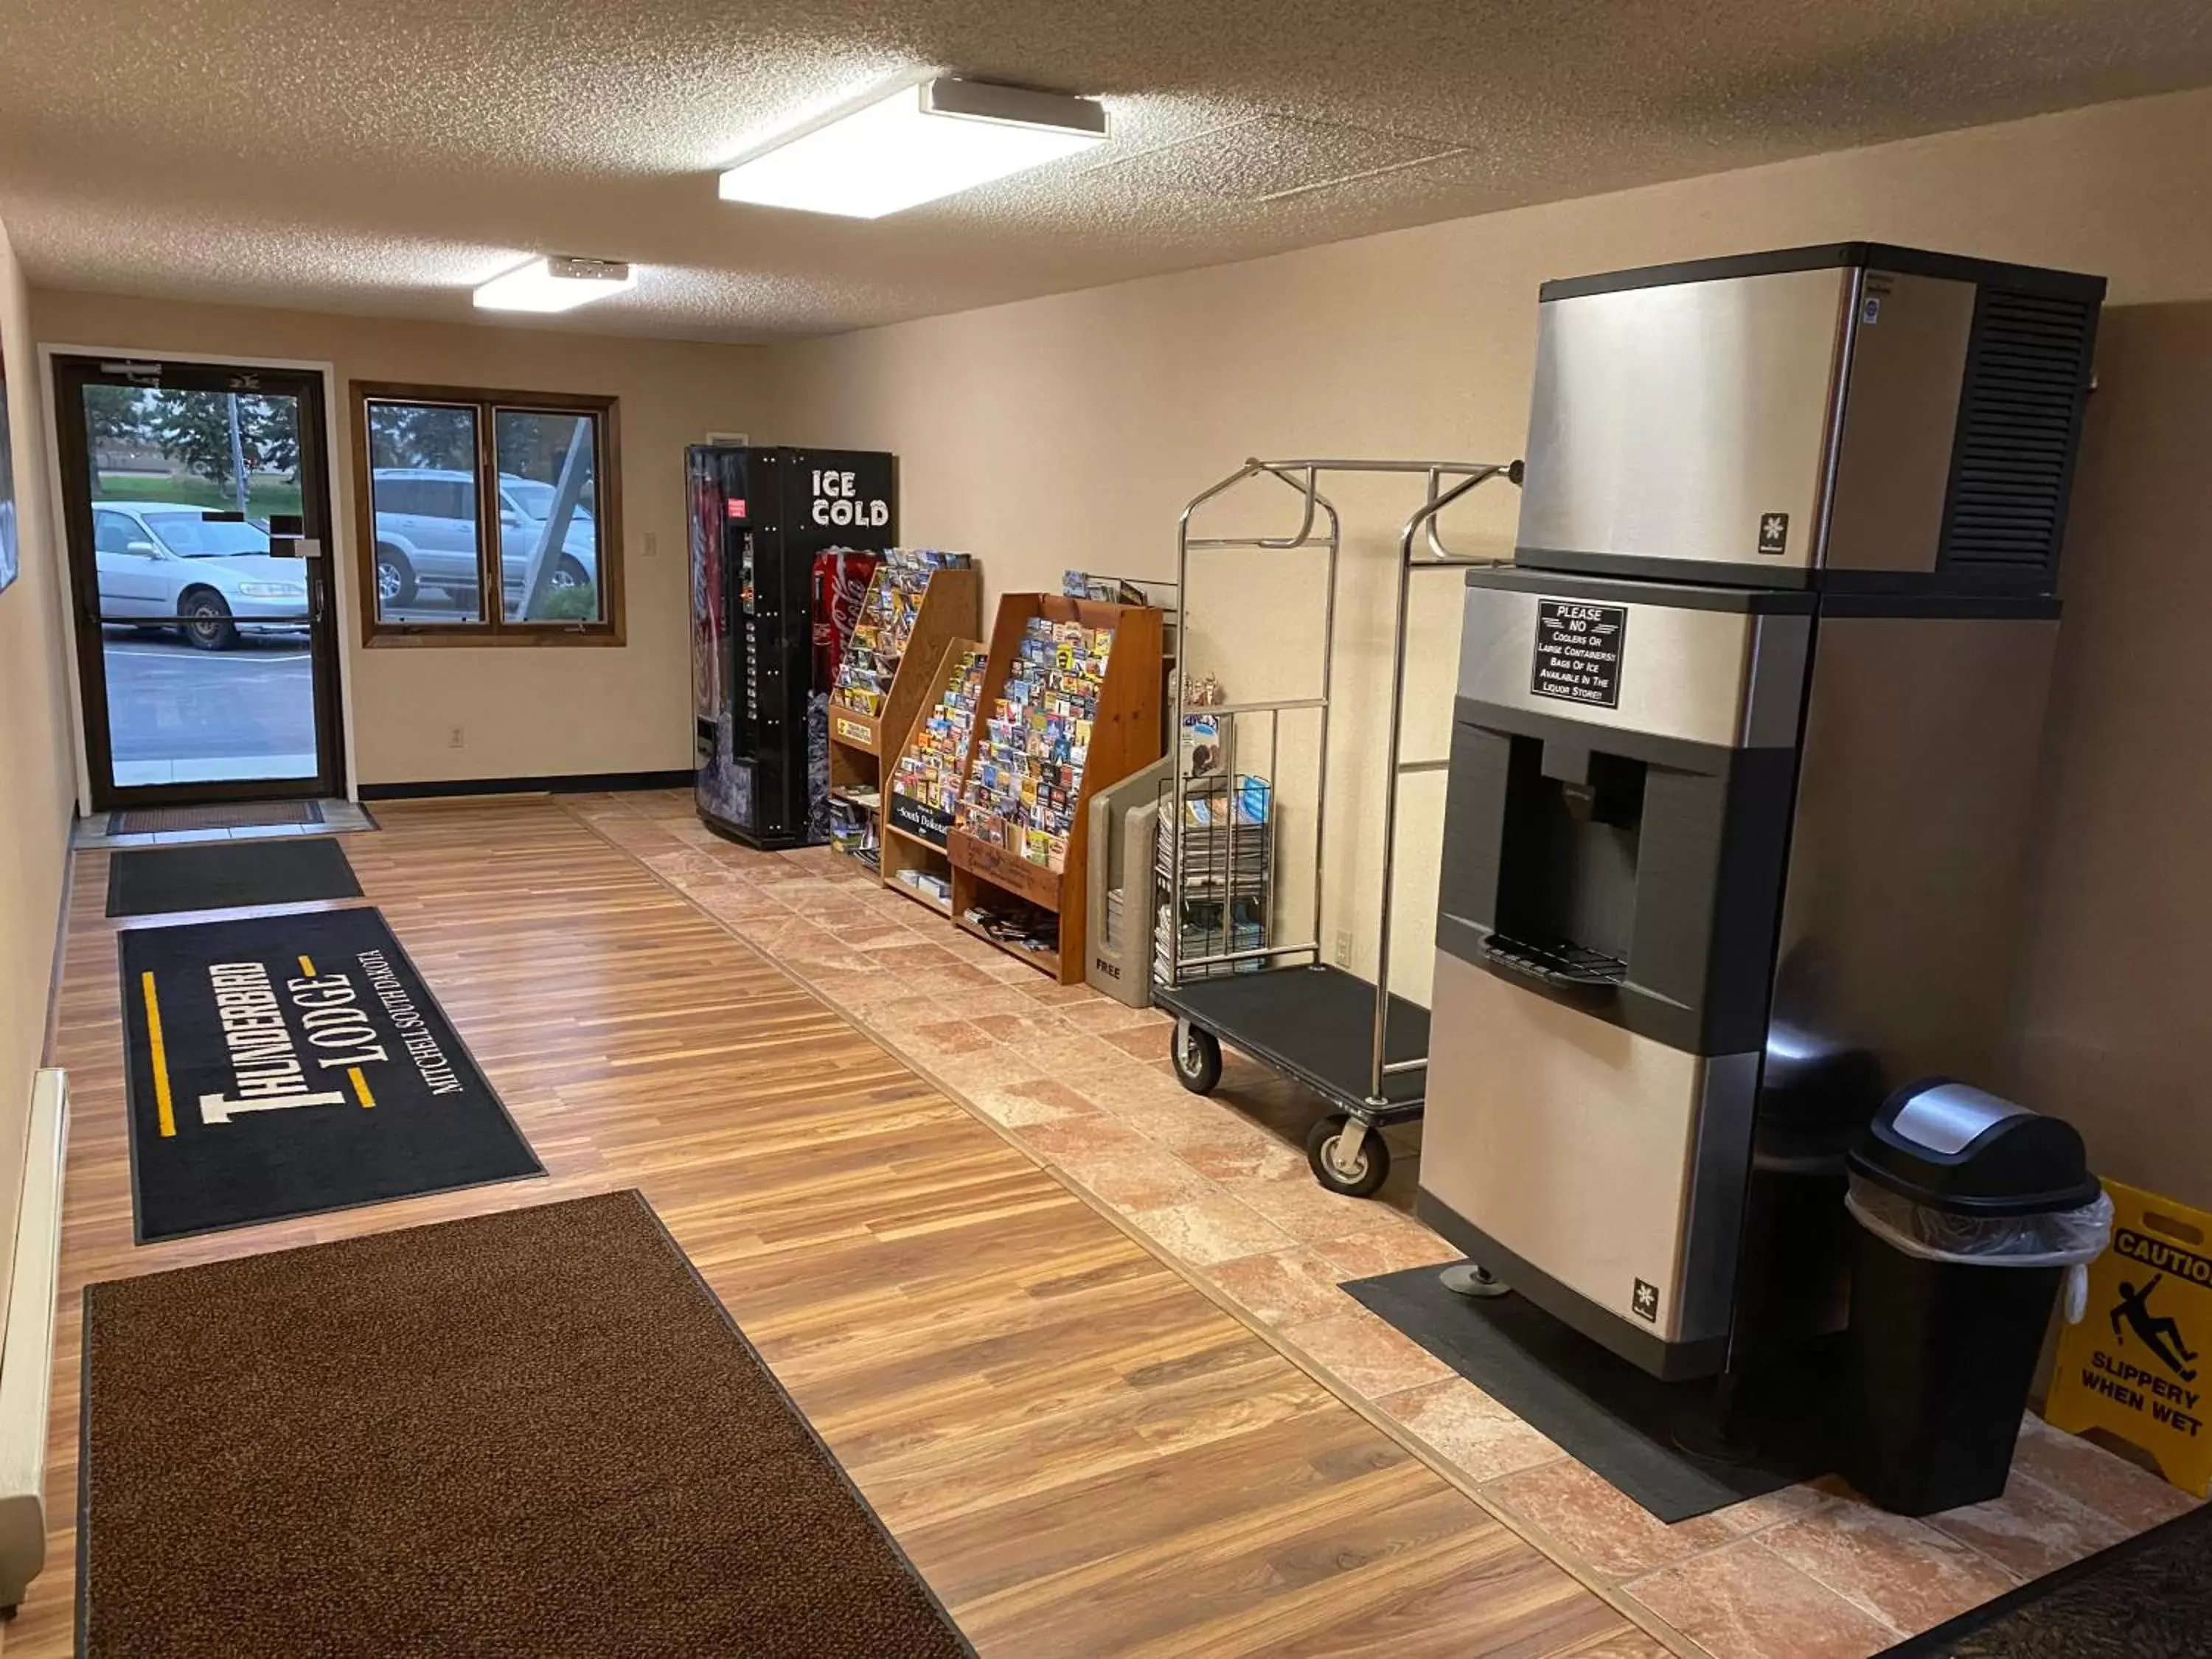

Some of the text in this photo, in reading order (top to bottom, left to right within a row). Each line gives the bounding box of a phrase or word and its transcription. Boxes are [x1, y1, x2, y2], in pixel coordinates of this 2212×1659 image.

[812, 470, 856, 498] ICE
[812, 498, 888, 529] COLD
[1557, 605, 1603, 622] PLEASE
[1569, 620, 1587, 632] NO
[1096, 958, 1121, 980] FREE
[200, 961, 346, 1126] THUNDERBIRD
[287, 973, 389, 1069] LODGE
[355, 949, 464, 1096] MITCHELL SOUTH DAKOTA
[2117, 1232, 2212, 1286] CAUTIO
[2081, 1368, 2202, 1438] WHEN WET
[2090, 1350, 2201, 1411] SLIPPERY
